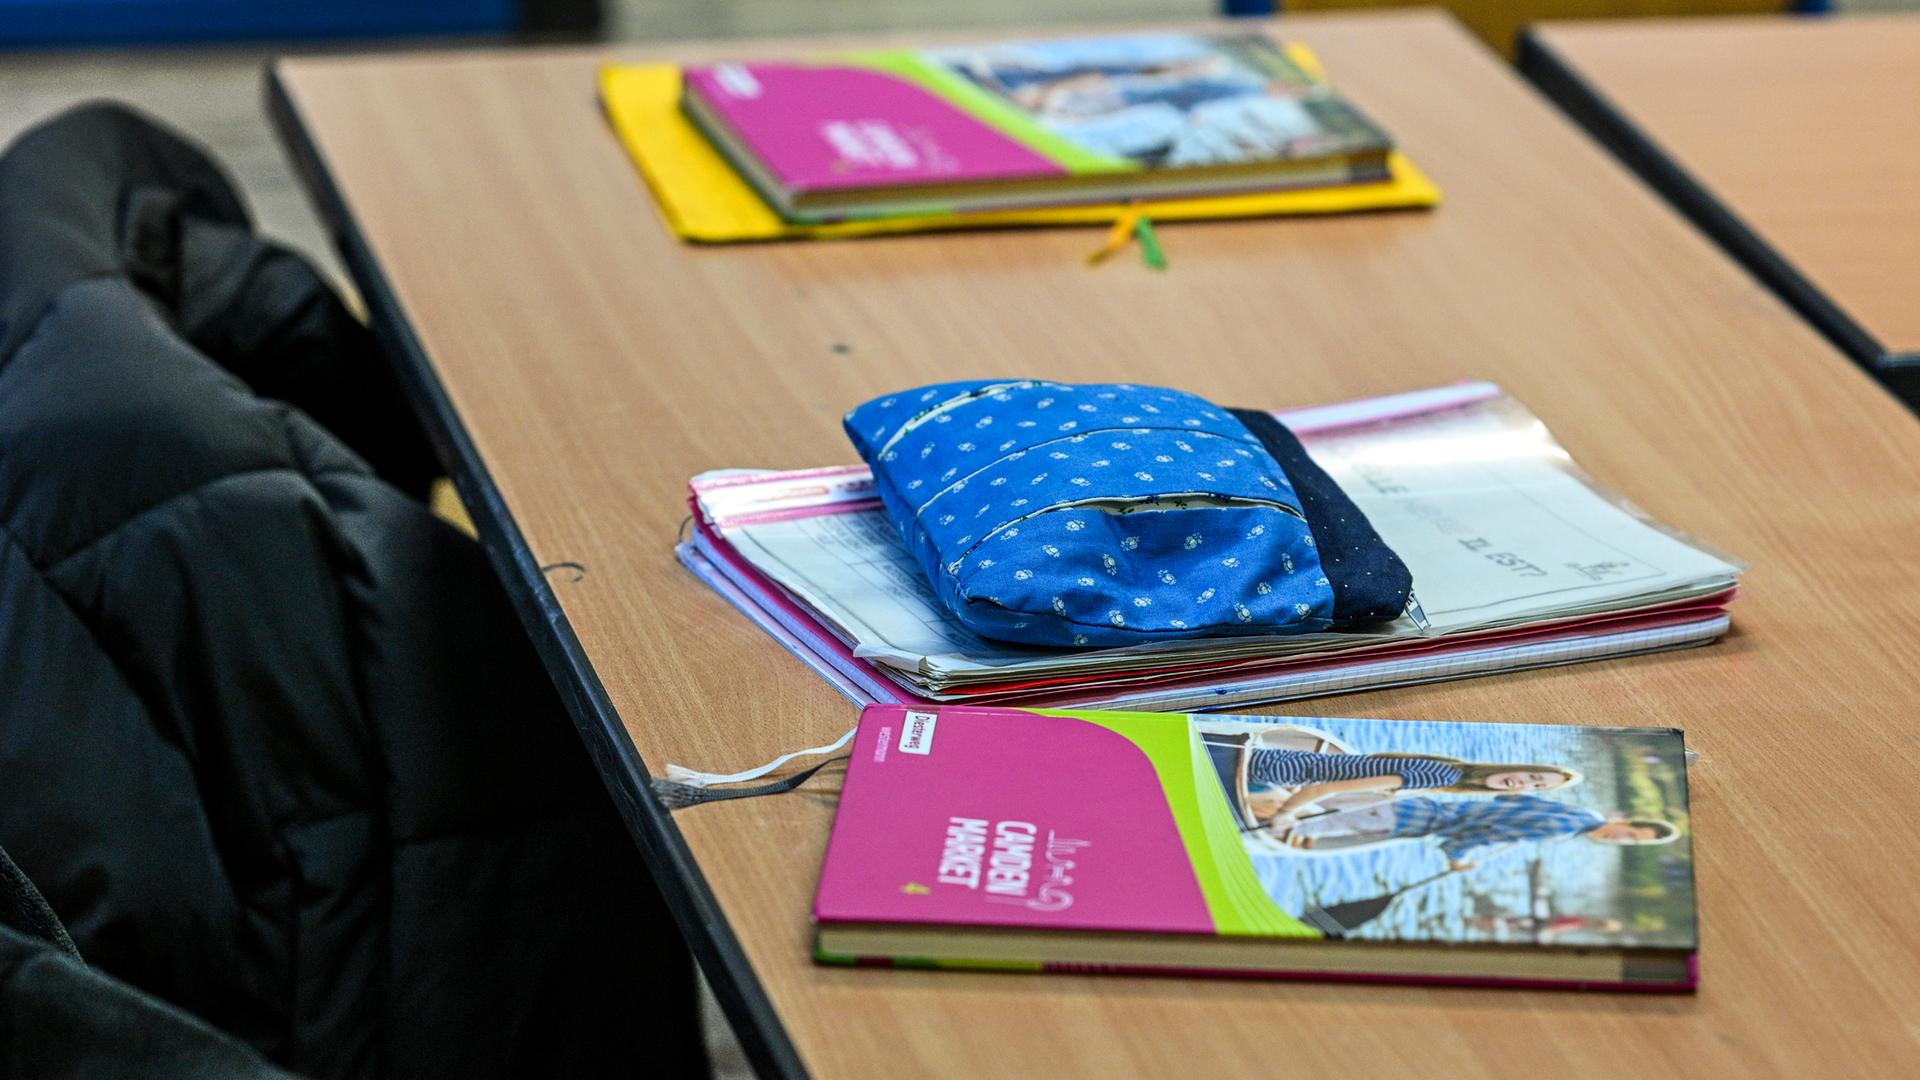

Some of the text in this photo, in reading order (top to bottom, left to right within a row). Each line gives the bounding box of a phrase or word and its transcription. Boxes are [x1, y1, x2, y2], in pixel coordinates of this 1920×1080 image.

[1484, 552, 1549, 577] EST?
[904, 715, 931, 749] Diesterweg
[937, 816, 990, 889] MARKET
[985, 819, 1038, 897] CAMDEN
